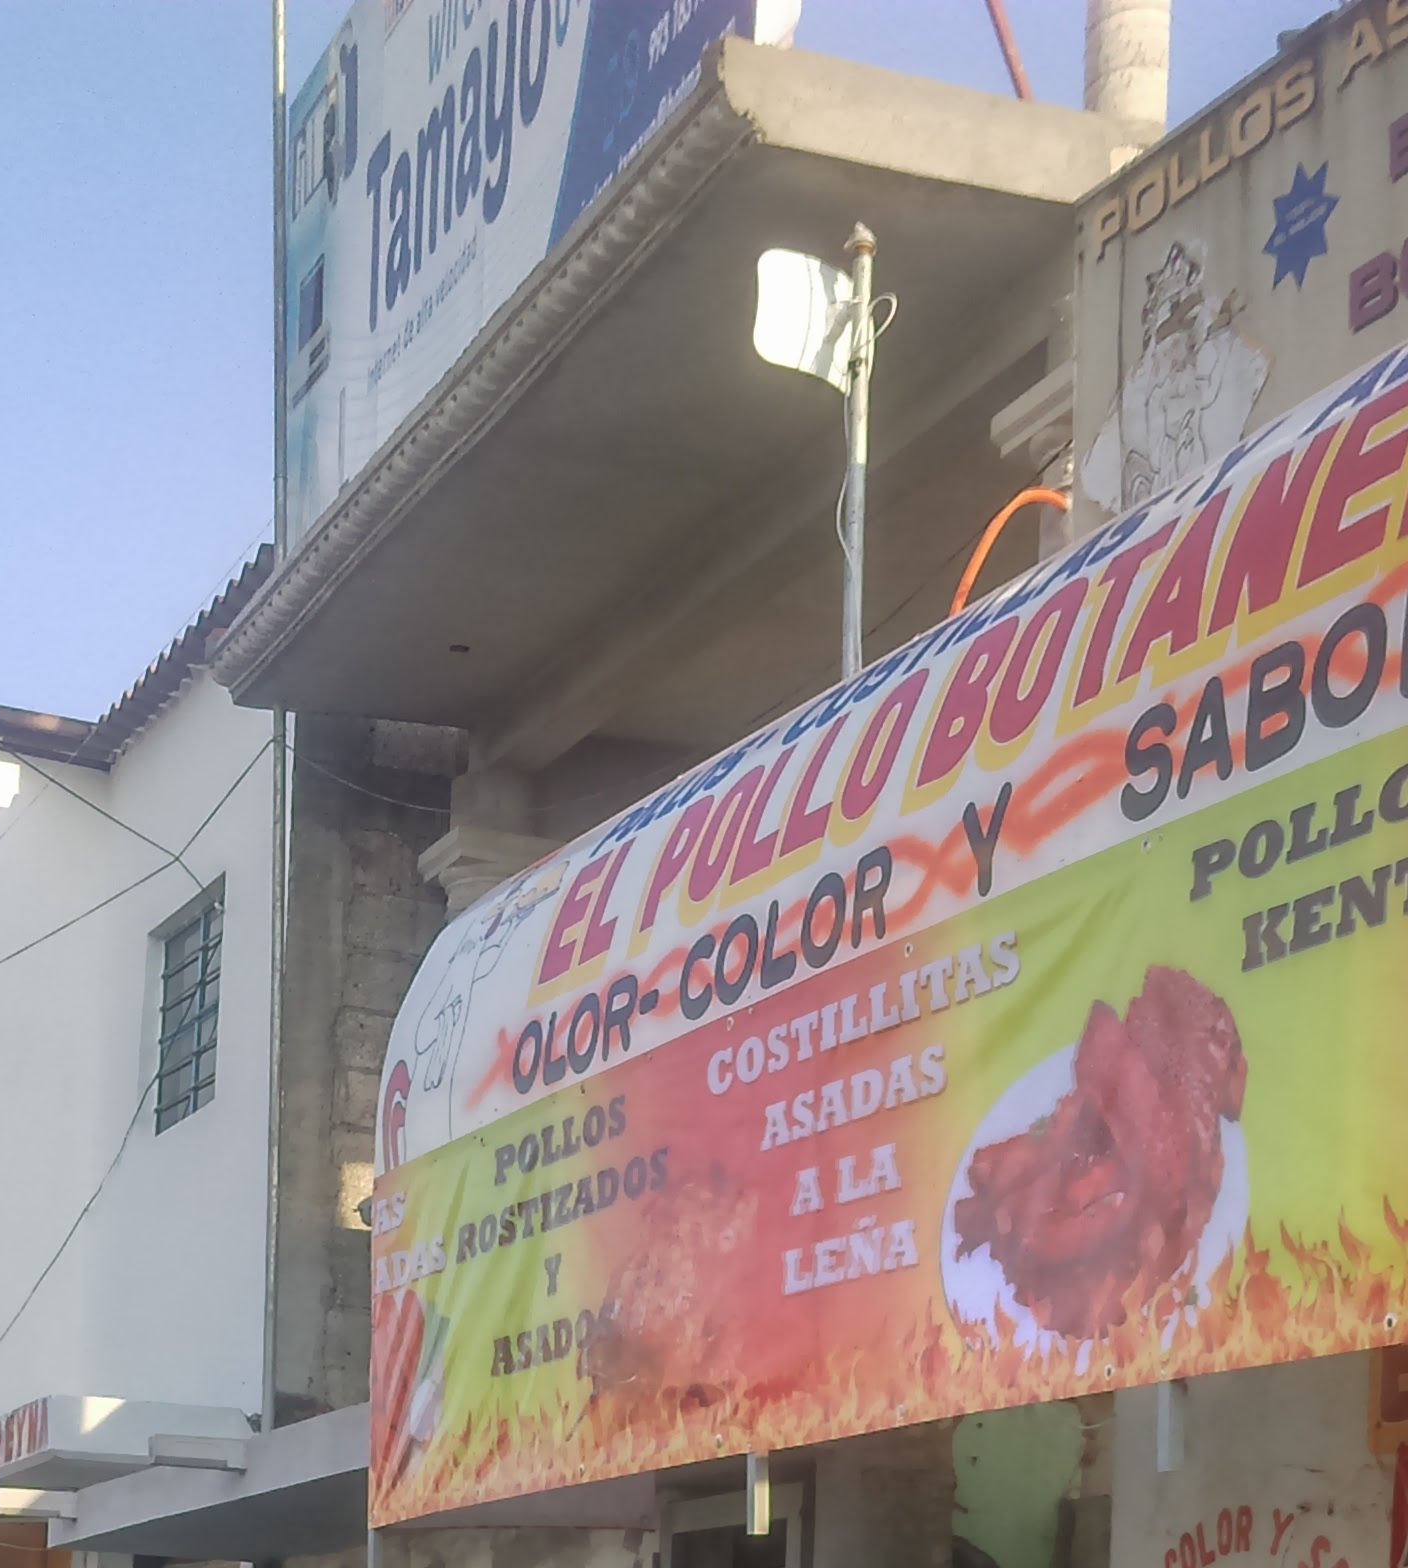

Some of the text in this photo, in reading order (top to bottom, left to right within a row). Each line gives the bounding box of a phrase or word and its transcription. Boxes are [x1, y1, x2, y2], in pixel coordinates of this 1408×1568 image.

[367, 0, 551, 332] Tamayo
[1093, 59, 1318, 263] POLLOS
[537, 836, 637, 985] EL
[639, 667, 930, 934] POLLO
[679, 845, 893, 1021] COLOR
[963, 782, 1013, 898] Y
[706, 929, 1022, 1097] COSTILLITAS
[494, 1094, 627, 1186] POLLOS
[760, 1043, 948, 1152] ASADAS
[455, 1145, 671, 1266] ROSTIZADOS
[789, 1142, 903, 1217] A LA
[544, 1253, 562, 1298] Y
[782, 1214, 920, 1295] LEÑA
[1269, 1508, 1294, 1556] Y
